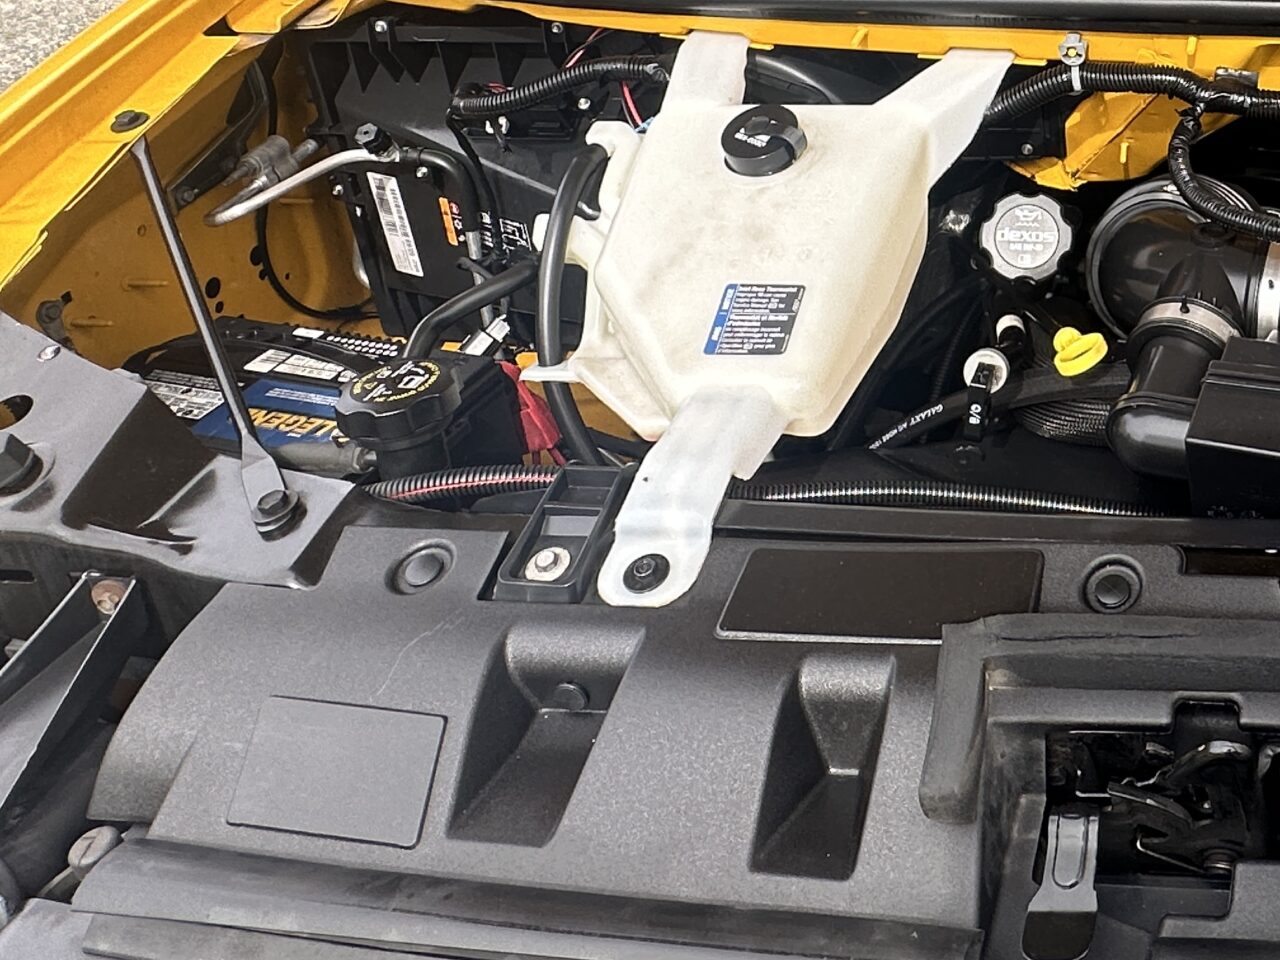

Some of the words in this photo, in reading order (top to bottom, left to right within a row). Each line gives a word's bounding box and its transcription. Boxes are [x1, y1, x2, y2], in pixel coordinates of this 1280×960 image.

[996, 227, 1057, 243] dexos
[247, 407, 338, 438] LEGEN
[909, 404, 944, 427] GALAXY
